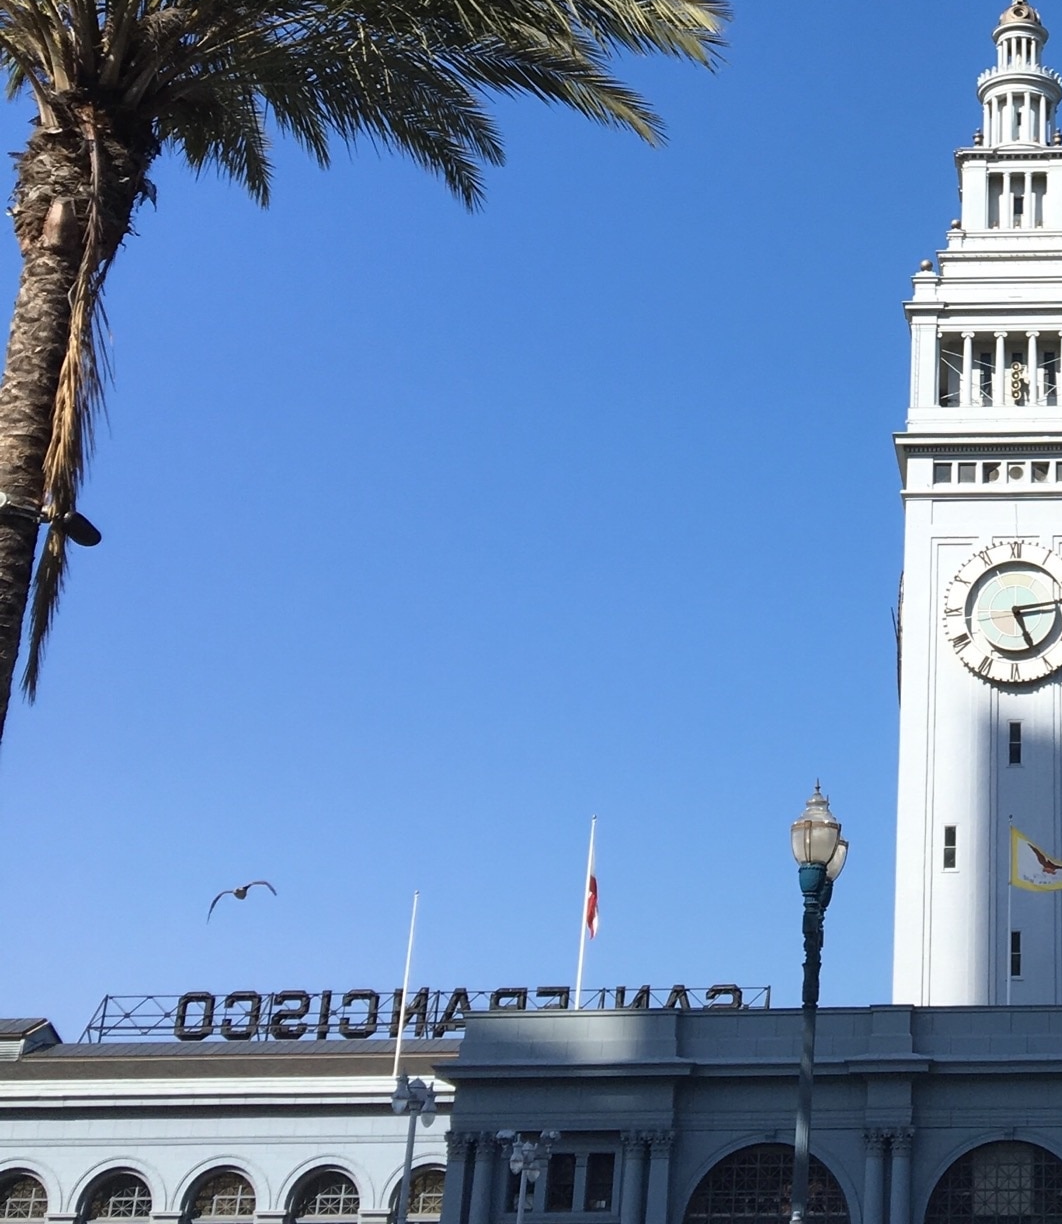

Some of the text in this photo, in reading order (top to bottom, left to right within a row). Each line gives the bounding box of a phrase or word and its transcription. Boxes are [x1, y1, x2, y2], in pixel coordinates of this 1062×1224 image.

[1010, 544, 1022, 559] XII
[978, 551, 993, 568] XI
[954, 575, 972, 587] X
[946, 607, 963, 618] IX
